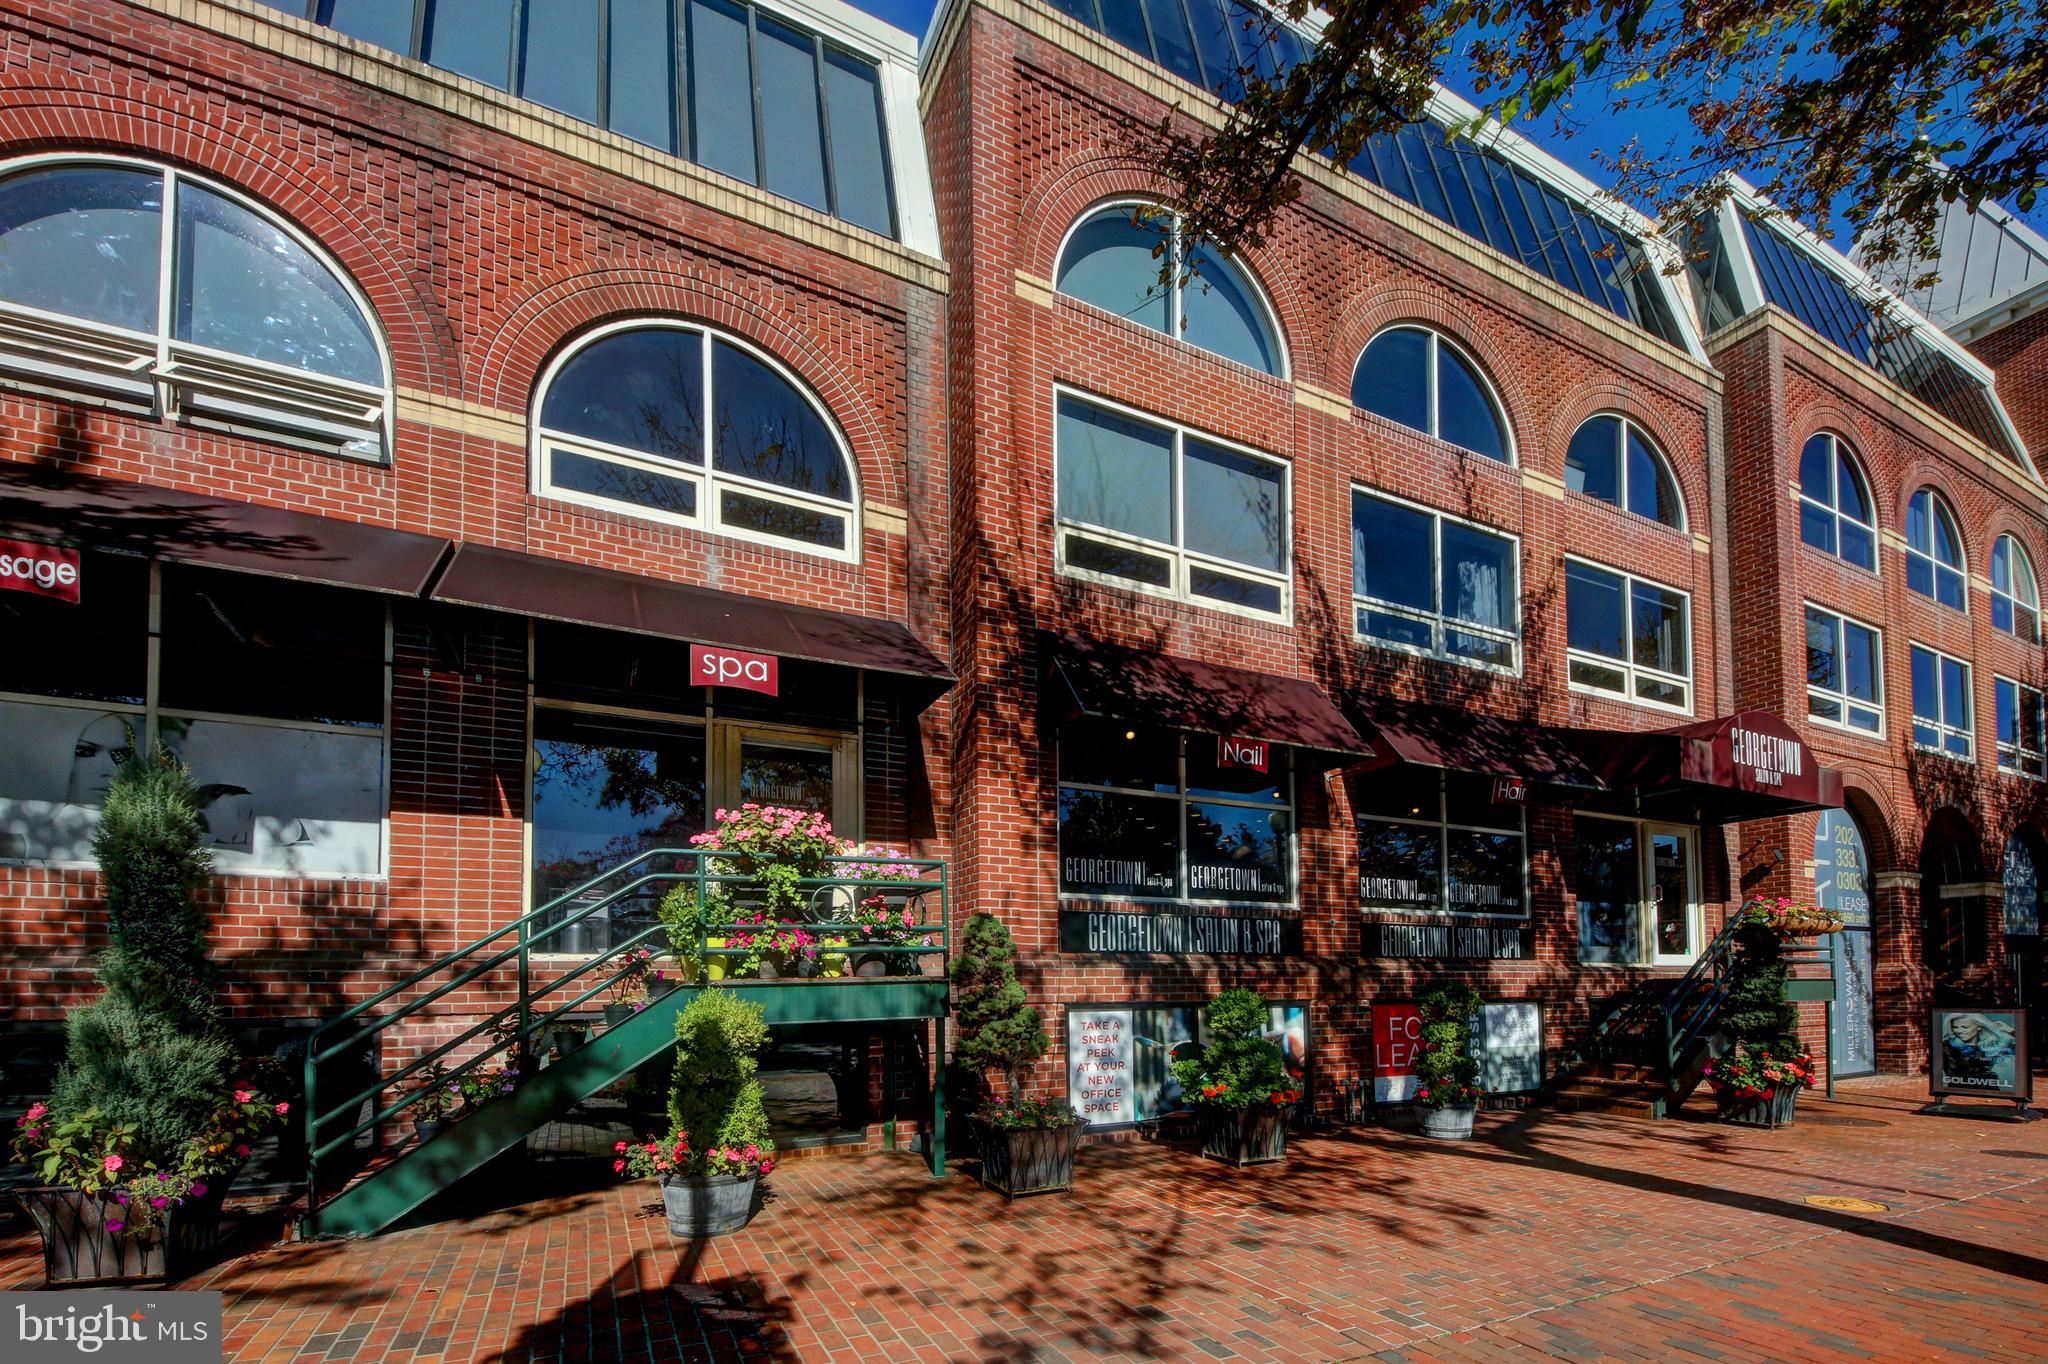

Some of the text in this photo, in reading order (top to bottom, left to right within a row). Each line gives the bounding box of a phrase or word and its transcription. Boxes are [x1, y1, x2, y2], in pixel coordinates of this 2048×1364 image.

[0, 554, 77, 589] sage
[702, 652, 769, 683] spa
[1224, 741, 1263, 766] Nail
[1731, 727, 1801, 776] GEORGETOWN
[1755, 767, 1783, 786] SALON & SPA
[1497, 780, 1527, 801] Hair
[1065, 857, 1141, 885] GEORGETOWN
[1191, 865, 1257, 891] GEORGETOWN
[1837, 871, 1863, 891] 0303
[1360, 876, 1415, 901] GEORGETOWN
[1840, 896, 1867, 912] LEASE
[1088, 913, 1281, 954] GEORGETOWN SALON & SPA
[1381, 924, 1521, 958] GEORGETOWN SALON & SPA
[1080, 1021, 1120, 1031] TAKE A
[1389, 1016, 1422, 1040] FO
[1082, 1034, 1120, 1044] SNEAK
[1846, 1013, 1856, 1062] MILLER
[1087, 1048, 1115, 1058] PEEK
[1077, 1061, 1125, 1072] AT YOUR
[1088, 1076, 1115, 1085] NEW
[1942, 1076, 2015, 1088] GOLDWELL
[1081, 1088, 1122, 1100] OFFICE
[1084, 1102, 1120, 1114] SPACE
